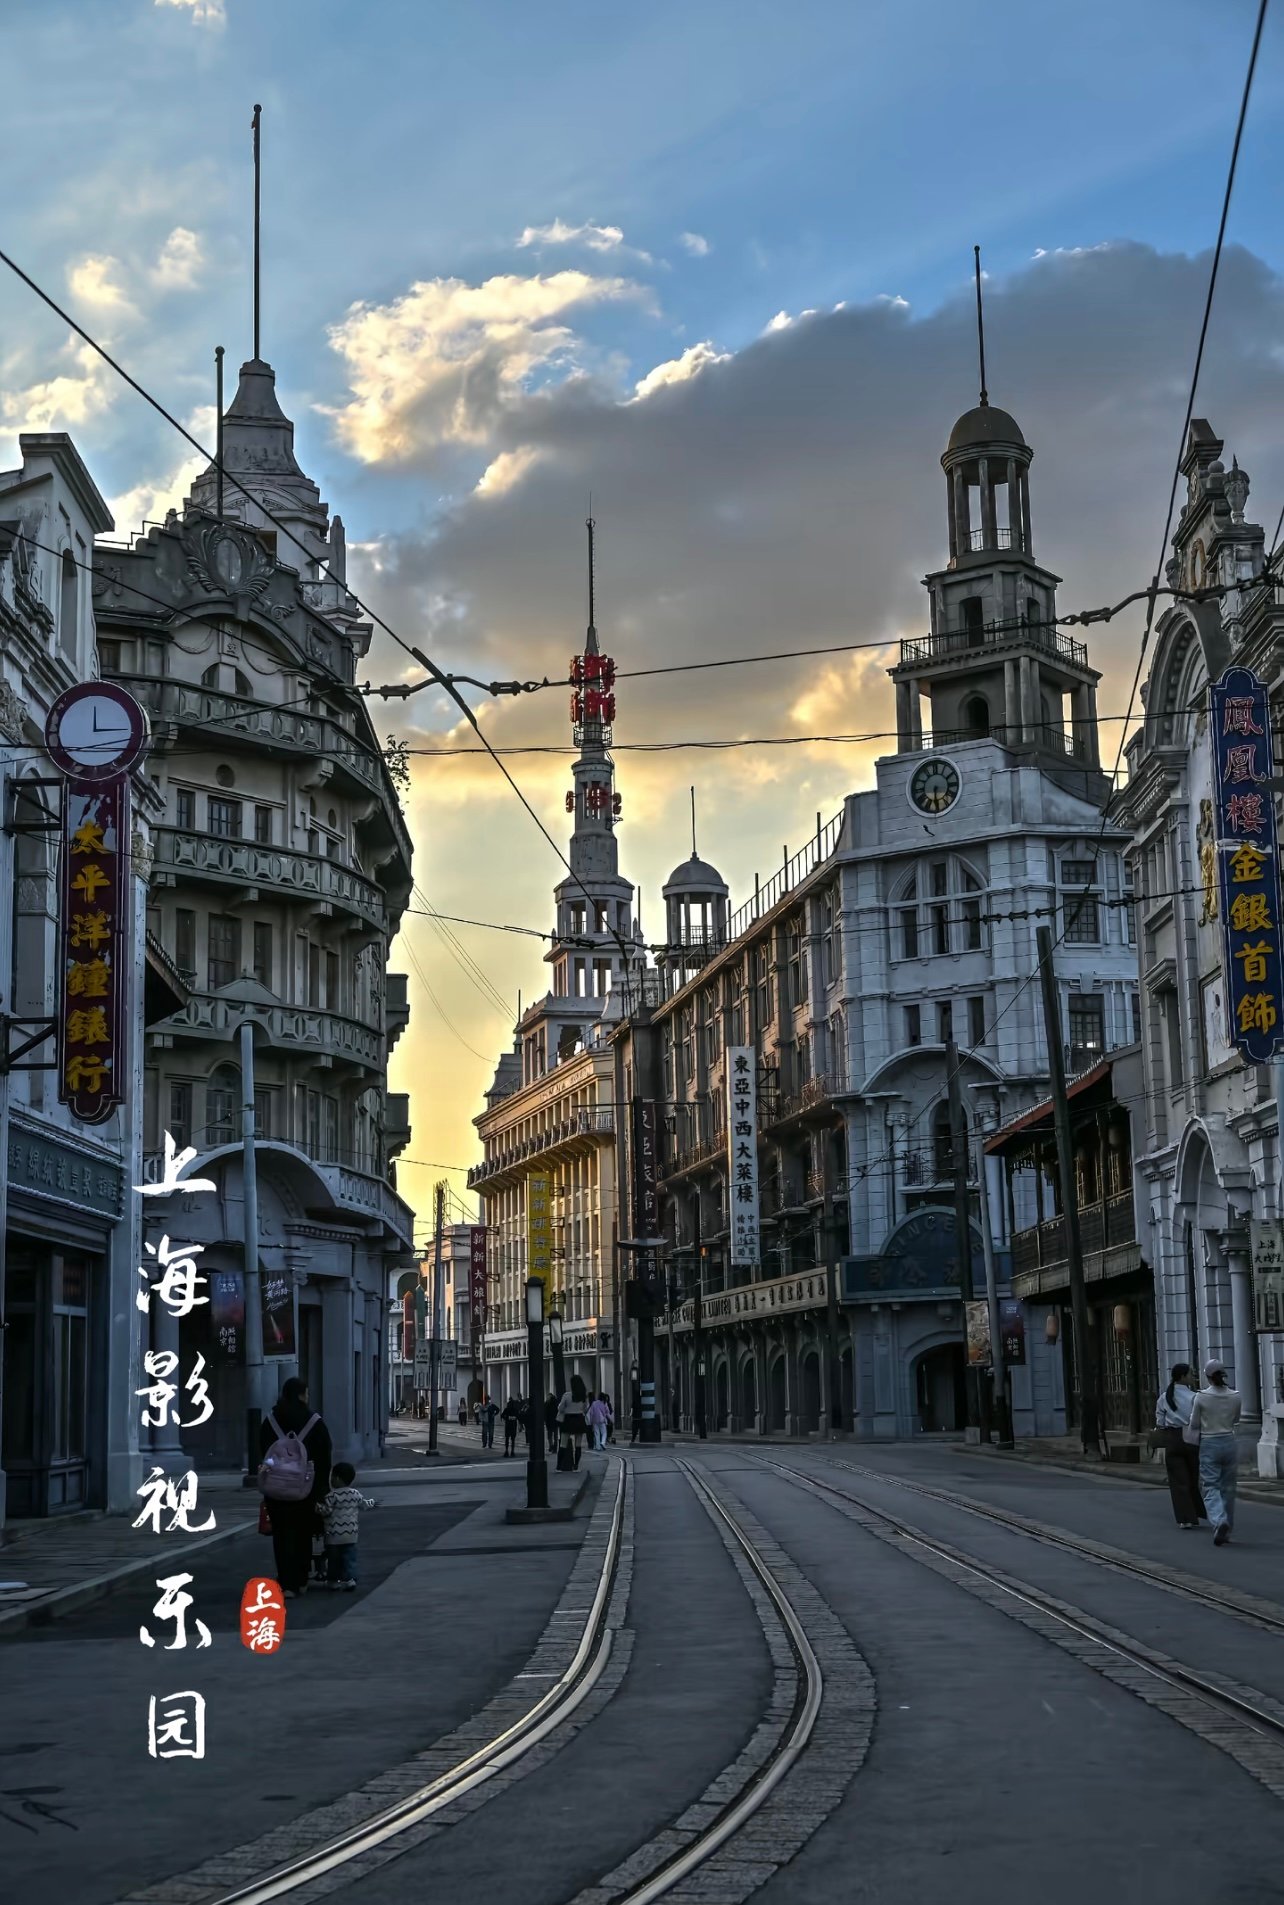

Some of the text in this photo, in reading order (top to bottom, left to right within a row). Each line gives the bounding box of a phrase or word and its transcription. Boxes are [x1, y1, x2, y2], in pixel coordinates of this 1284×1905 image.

[1223, 694, 1278, 1034] 鳳凰樓金銀首飾
